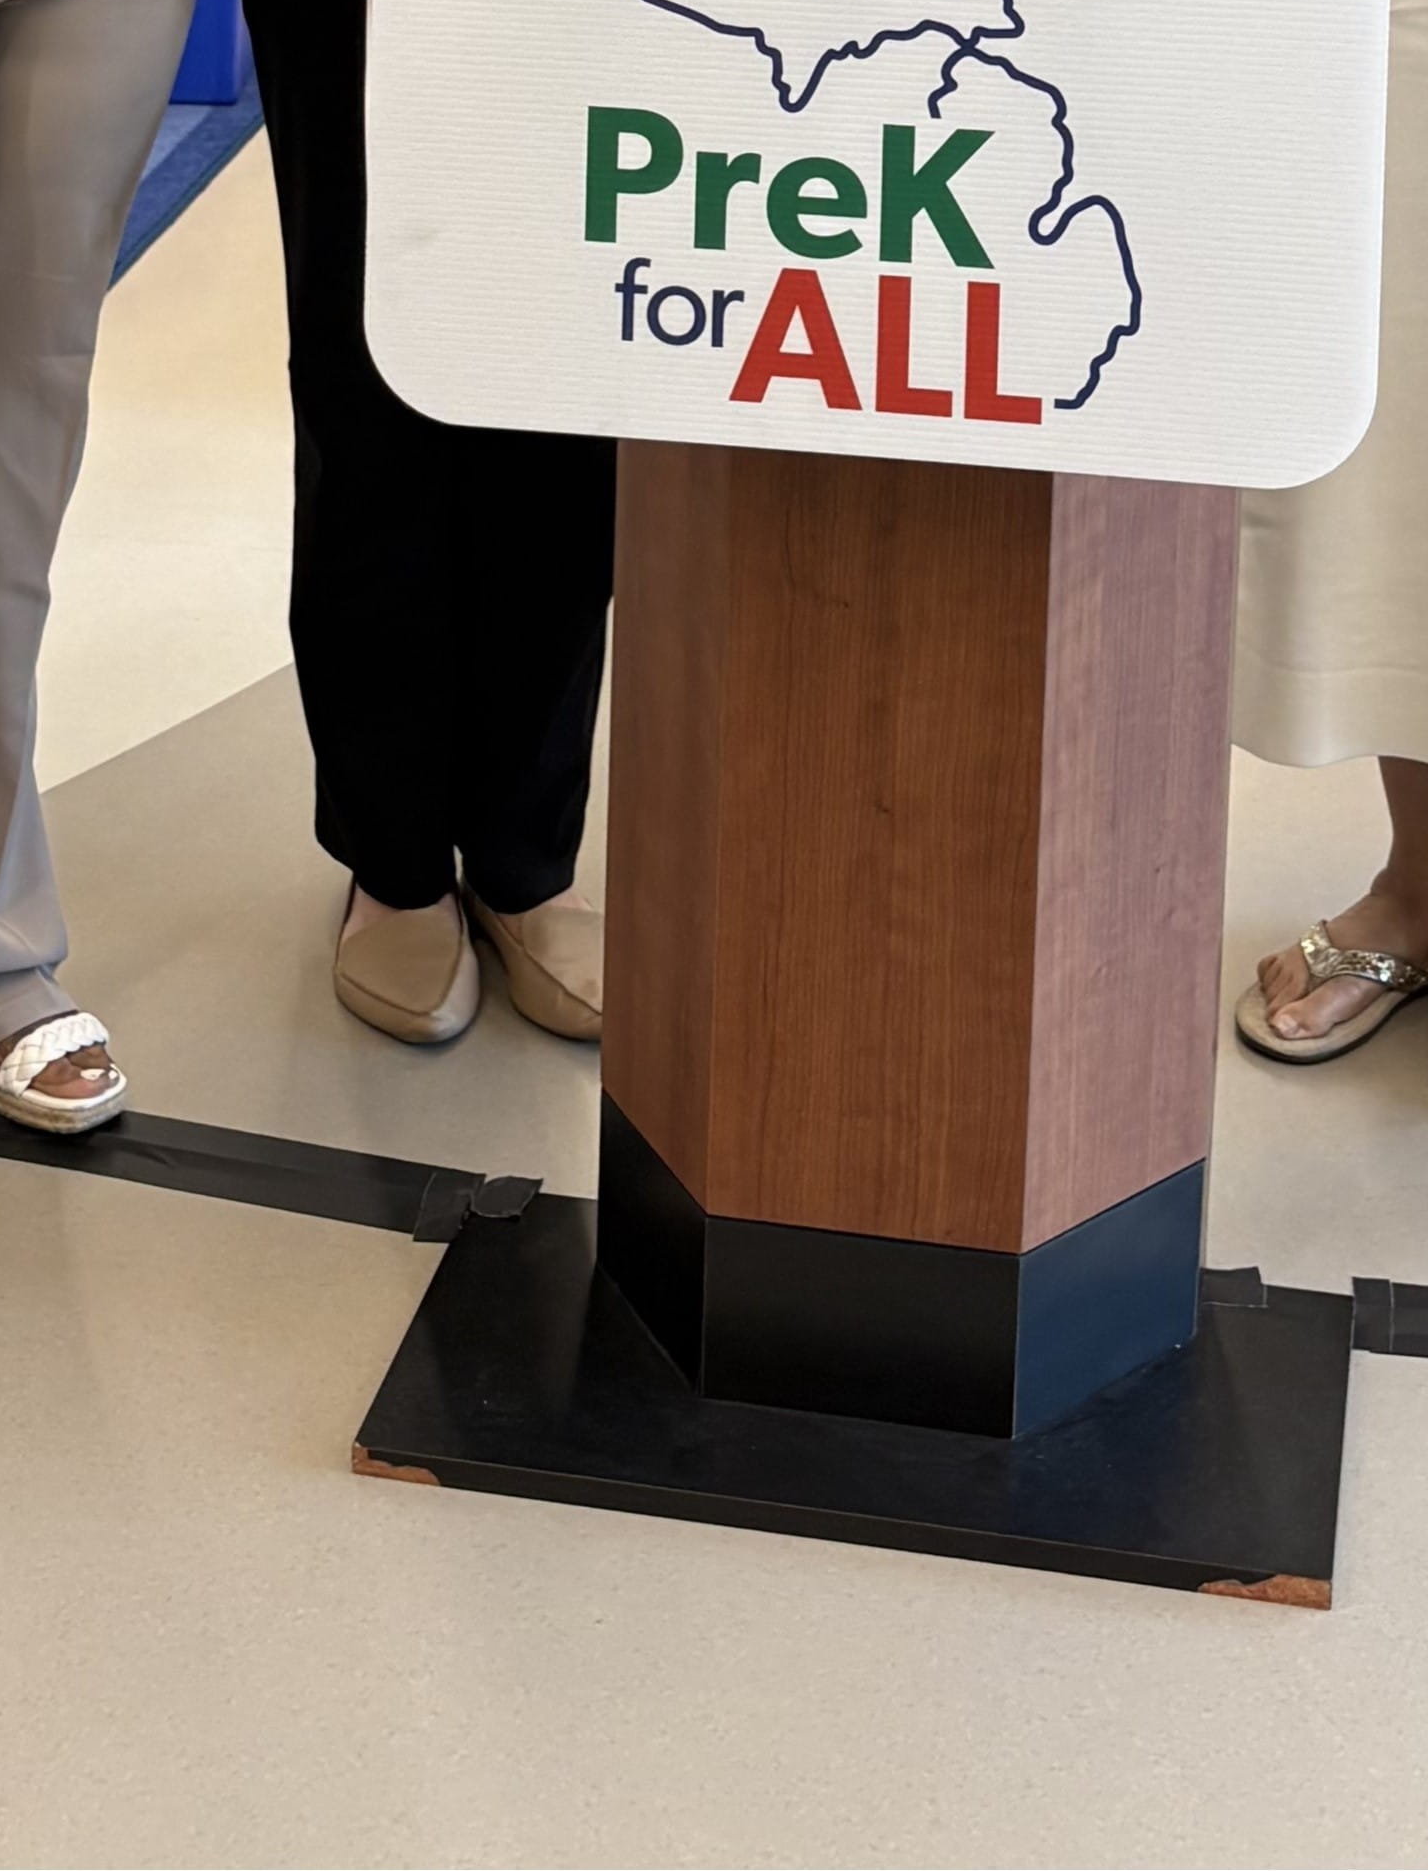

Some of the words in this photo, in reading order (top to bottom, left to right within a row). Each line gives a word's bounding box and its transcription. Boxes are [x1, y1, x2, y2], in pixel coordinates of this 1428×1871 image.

[584, 105, 994, 270] PreK
[615, 257, 745, 349] for
[729, 268, 1044, 426] ALL
